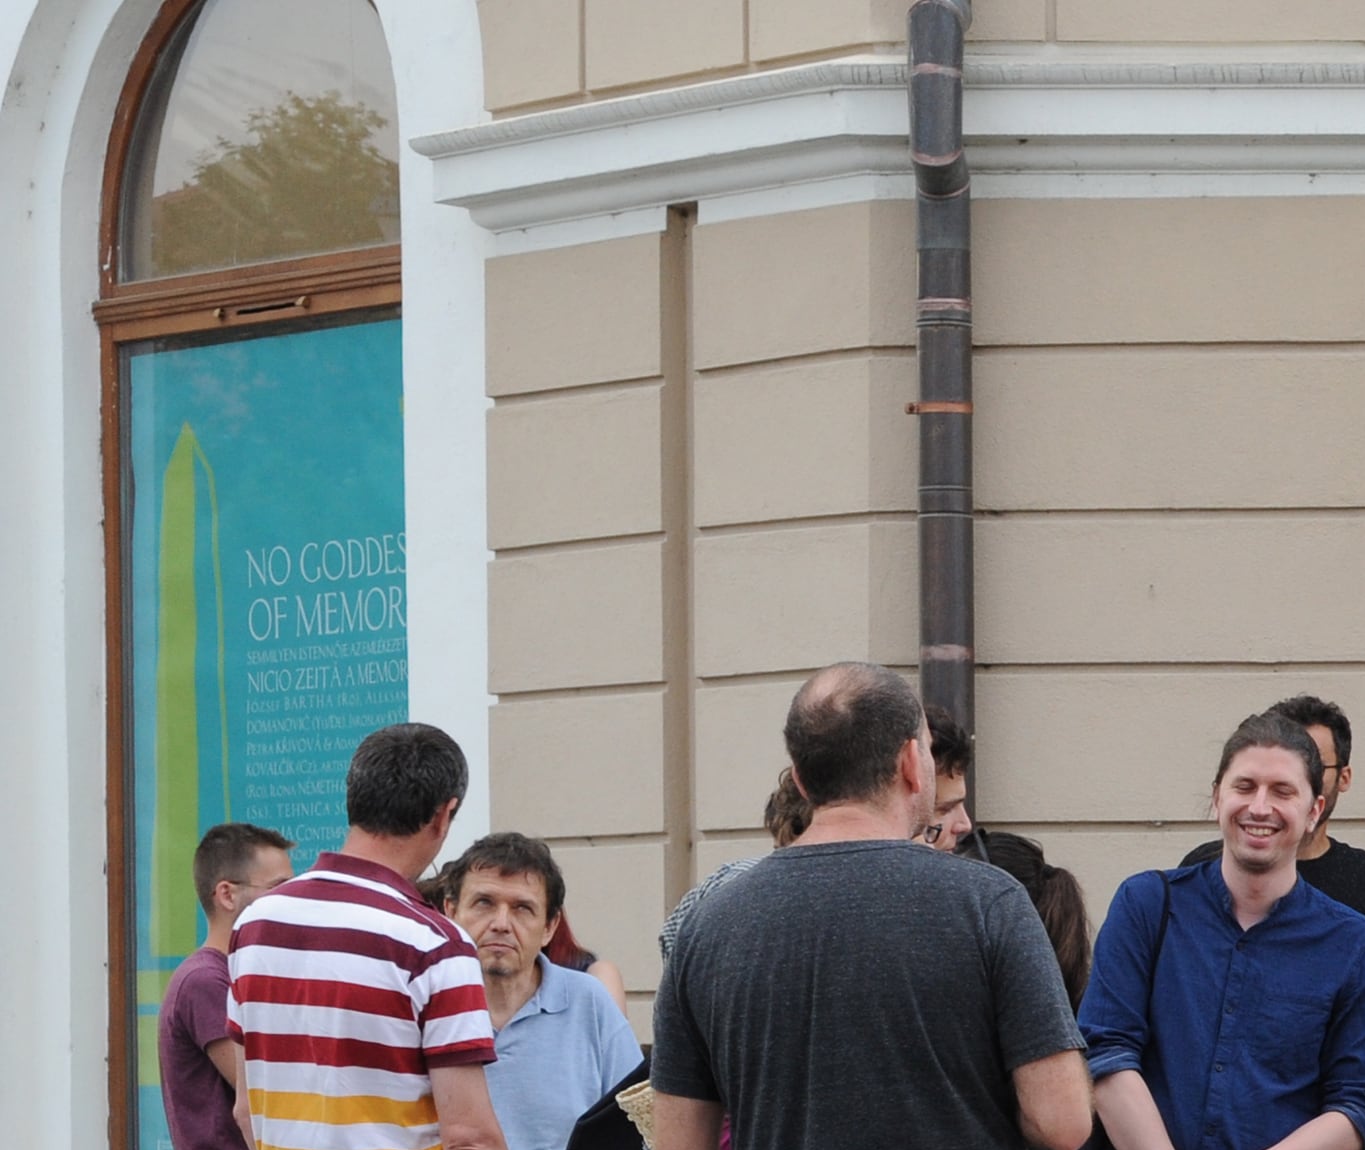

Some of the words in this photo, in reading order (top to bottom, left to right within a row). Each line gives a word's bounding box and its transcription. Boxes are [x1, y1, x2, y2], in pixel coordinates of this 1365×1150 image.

[246, 545, 292, 588] NO
[300, 532, 407, 583] GODDES
[249, 596, 288, 641] OF
[296, 585, 407, 637] MEMOR
[247, 668, 292, 694] NICIO
[284, 694, 334, 711] BARTHA
